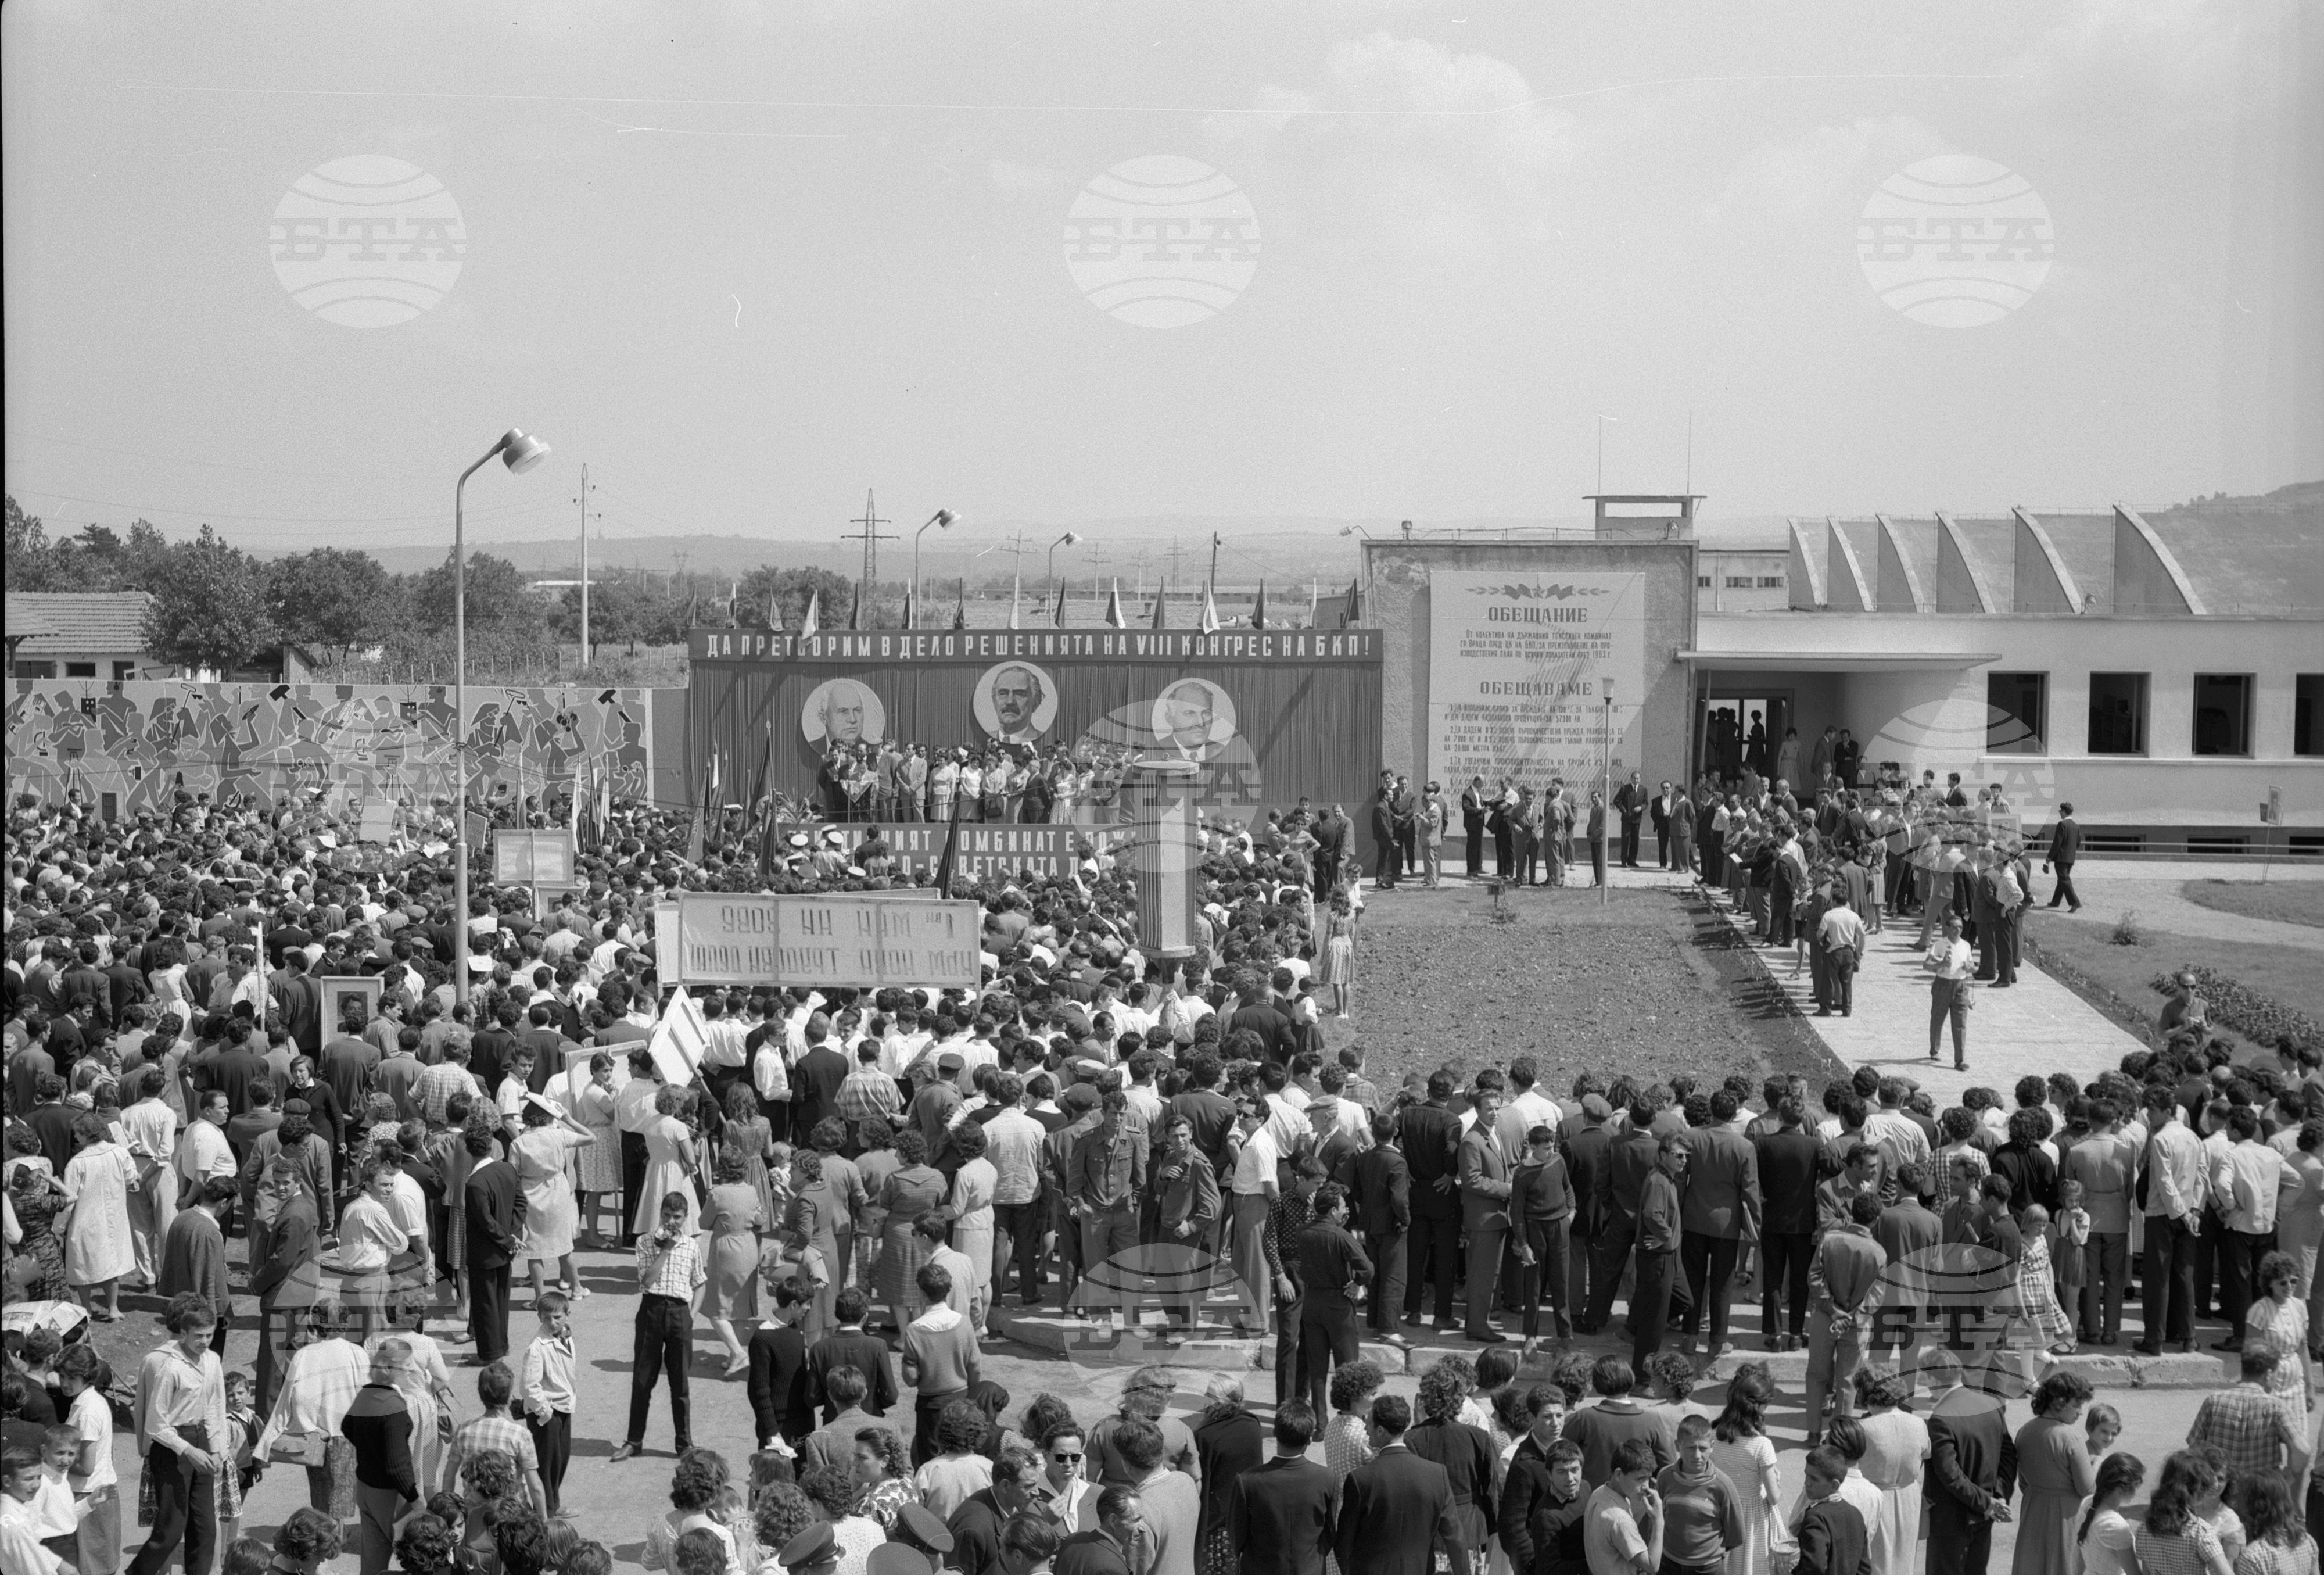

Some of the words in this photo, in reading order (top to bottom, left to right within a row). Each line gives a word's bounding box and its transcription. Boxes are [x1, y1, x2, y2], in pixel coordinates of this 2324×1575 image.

[1488, 607, 1588, 625] ОБЕЩАНИЕ
[1476, 631, 1505, 639] КОЛЕКТИВА
[1517, 632, 1549, 640] ДЪРЖАВНИЯ
[708, 635, 731, 658] ДА
[881, 636, 890, 656] В
[900, 636, 953, 659] ДЕЛО
[965, 635, 1093, 656] РЕШЕНИЯТА
[1104, 635, 1127, 656] НА
[1136, 635, 1172, 656] VIII
[1182, 635, 1271, 656] КОНГРЕС
[1283, 635, 1306, 656] НА
[1315, 635, 1369, 656] БКП!
[1469, 639, 1486, 648] ВРАЦА
[1489, 640, 1502, 649] ПРЕД
[1593, 650, 1606, 658] 1963
[1480, 681, 1593, 698] ОБЕЩАВАМЕ
[1461, 713, 1479, 721] ДАДЕМ
[1568, 759, 1584, 767] ТРУДА
[945, 831, 1056, 851] ОМБИНАТ
[1065, 831, 1074, 852] Е
